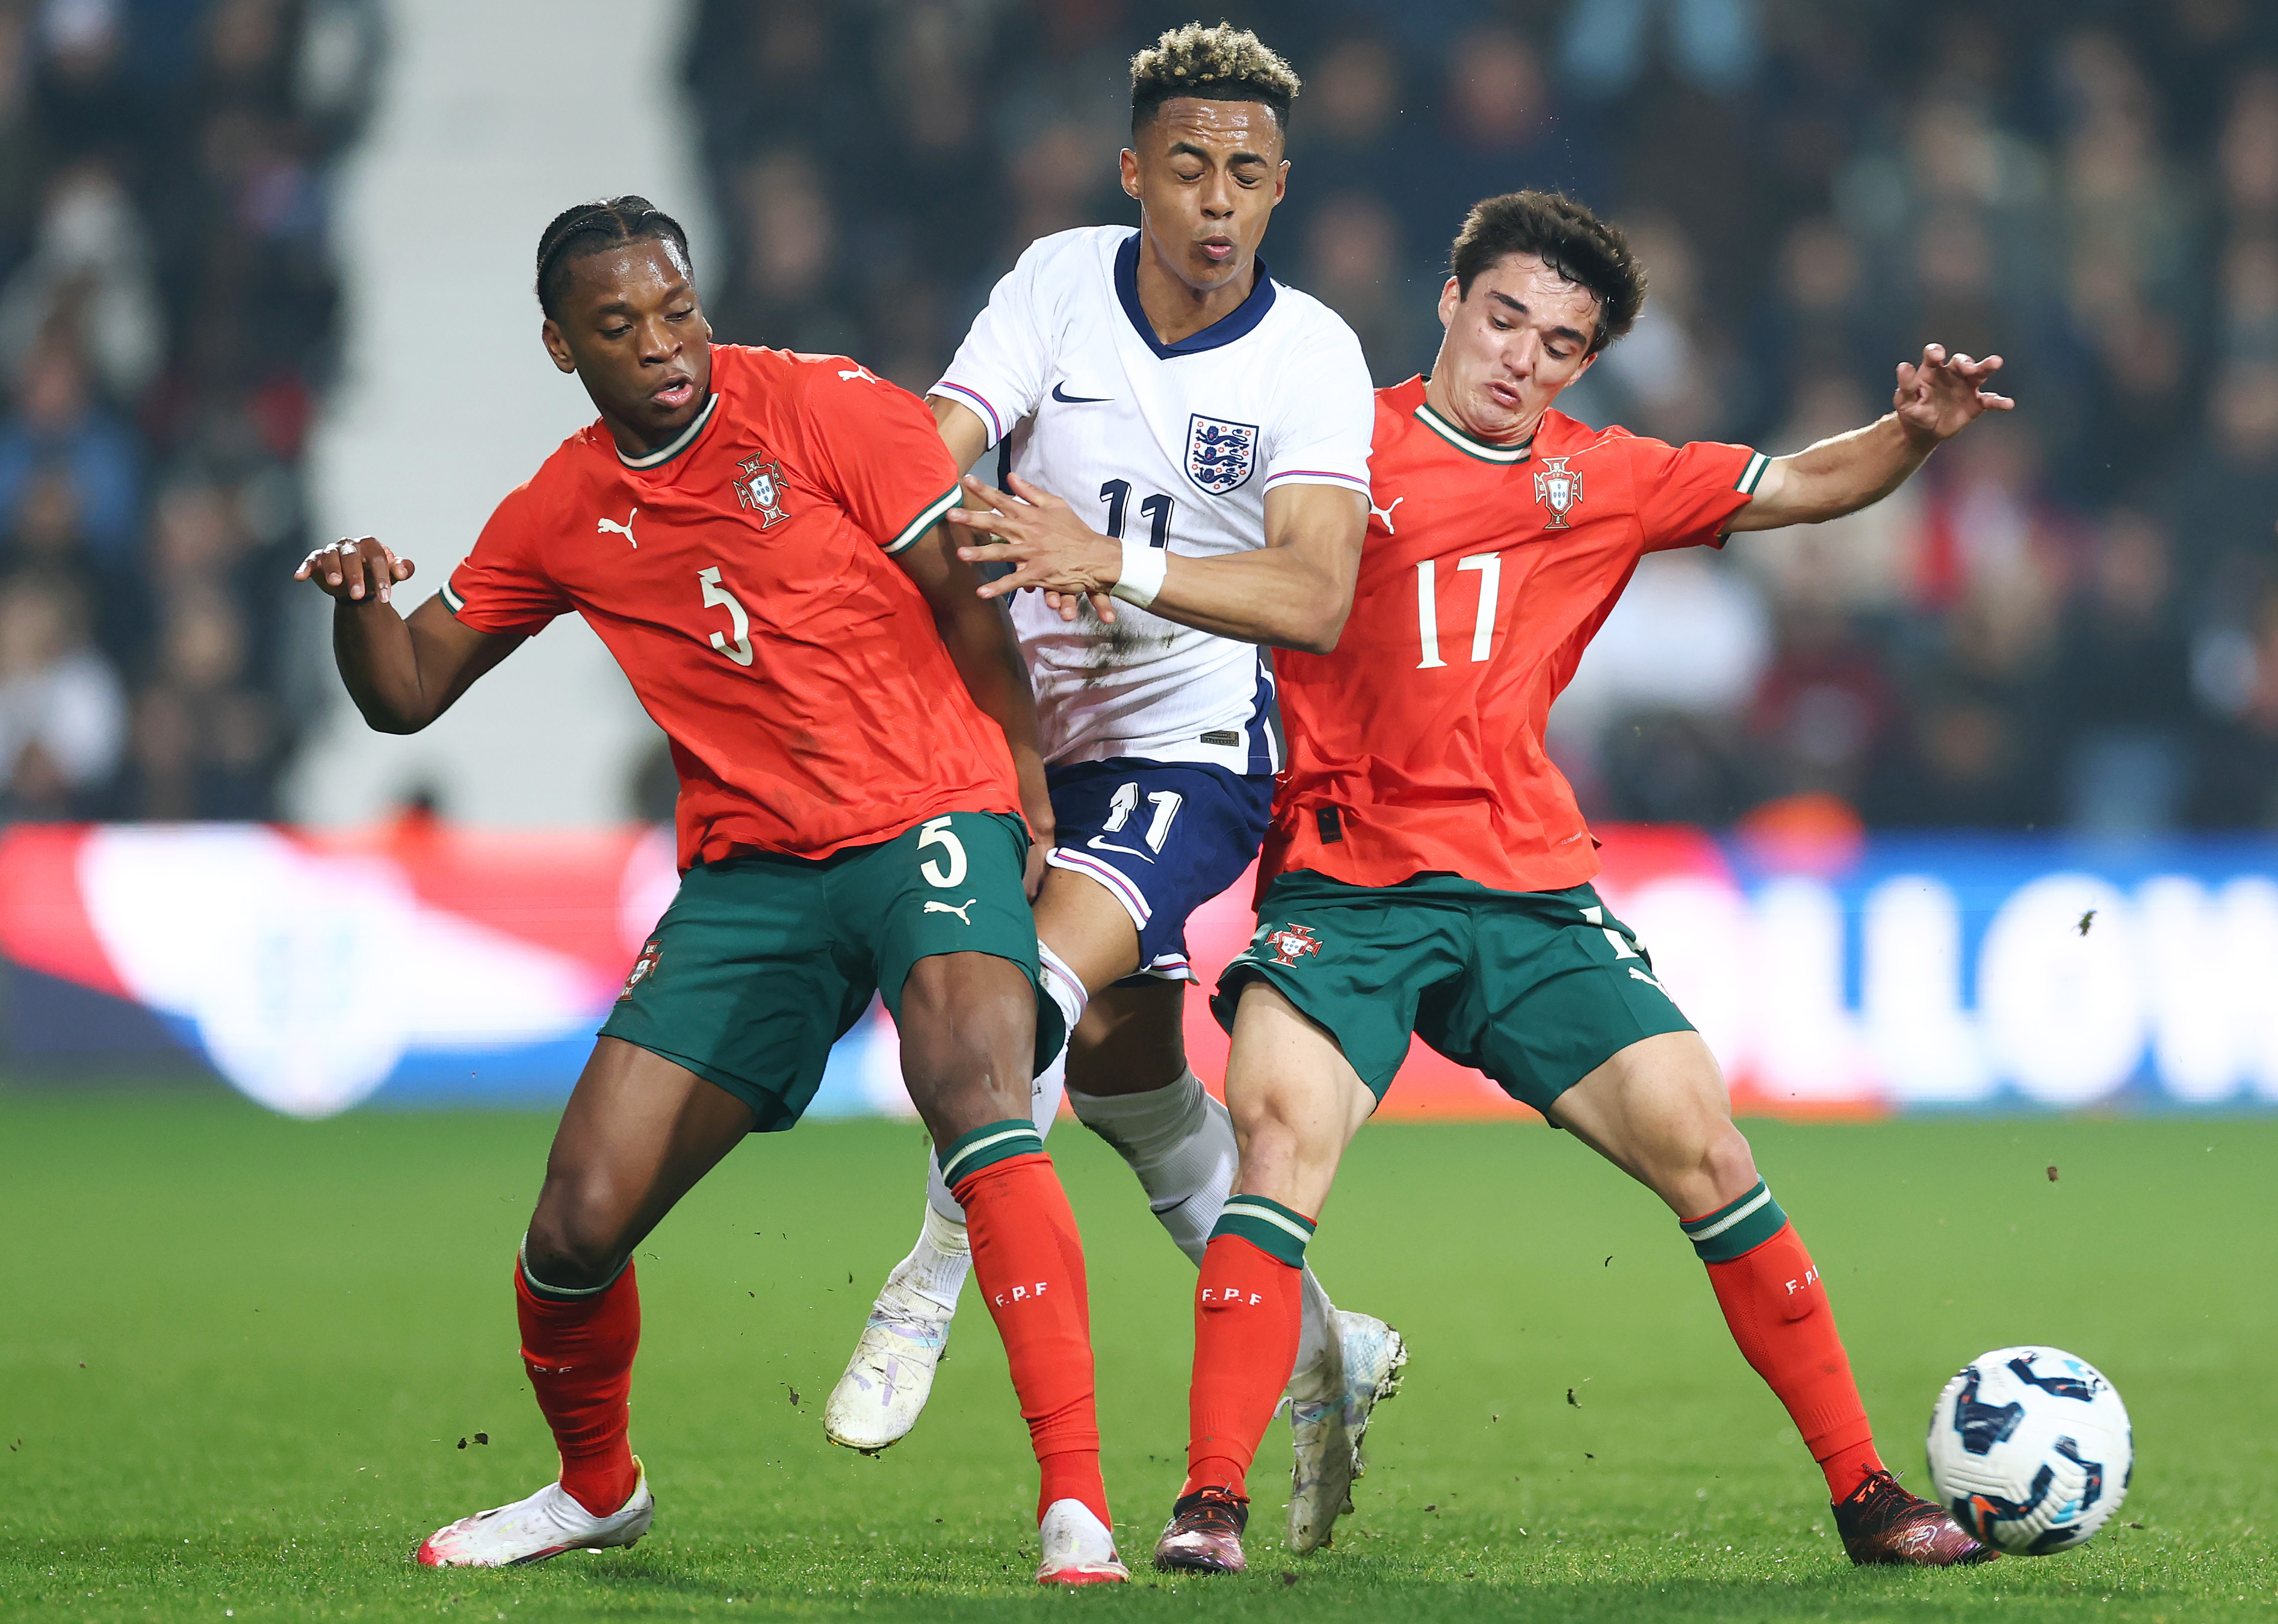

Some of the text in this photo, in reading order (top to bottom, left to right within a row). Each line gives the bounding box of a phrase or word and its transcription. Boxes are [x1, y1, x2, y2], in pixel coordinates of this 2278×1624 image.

[1100, 478, 1174, 551] 11
[697, 566, 754, 667] 5
[1416, 552, 1501, 669] 17
[916, 815, 967, 888] 5
[1102, 782, 1183, 855] 11
[1578, 906, 1645, 960] 1
